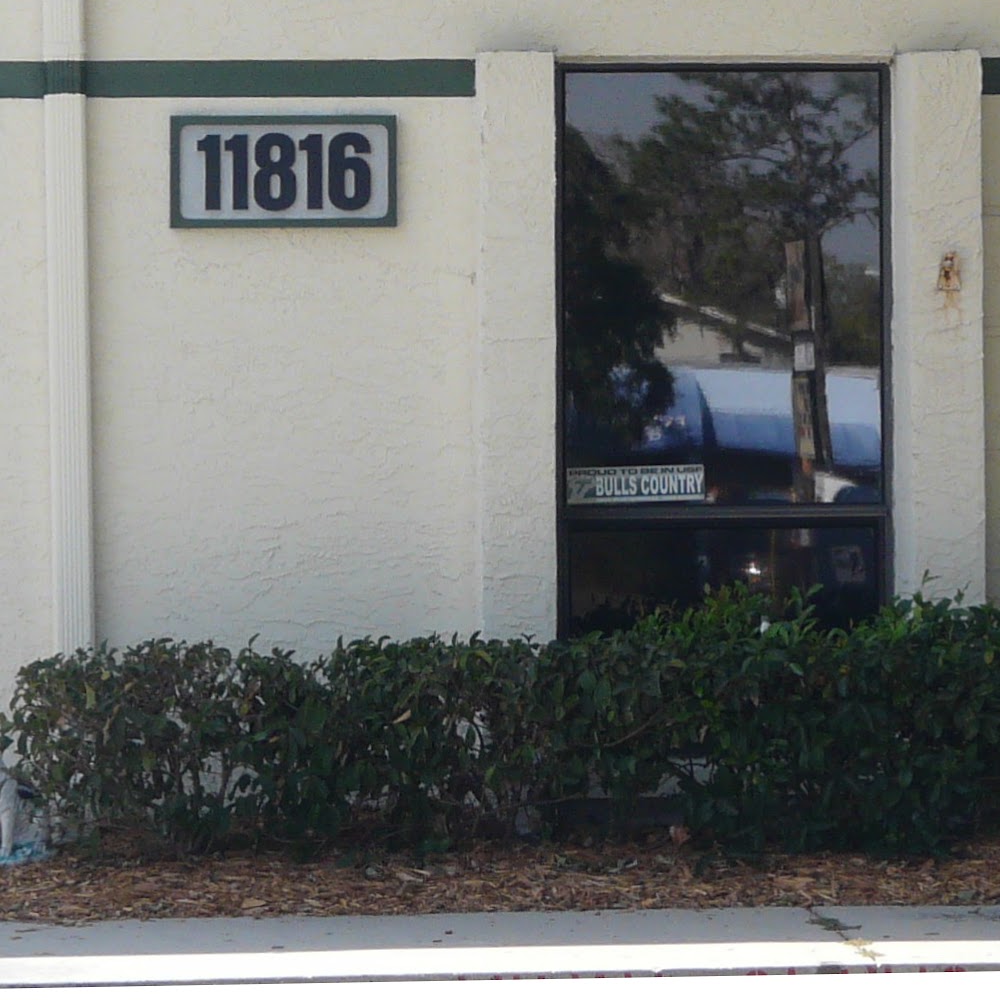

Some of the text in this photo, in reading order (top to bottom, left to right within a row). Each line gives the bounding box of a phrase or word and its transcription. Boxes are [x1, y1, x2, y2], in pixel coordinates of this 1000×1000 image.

[196, 132, 372, 211] 11816
[595, 472, 704, 496] BULLS COUNTRY
[621, 468, 638, 476] TO
